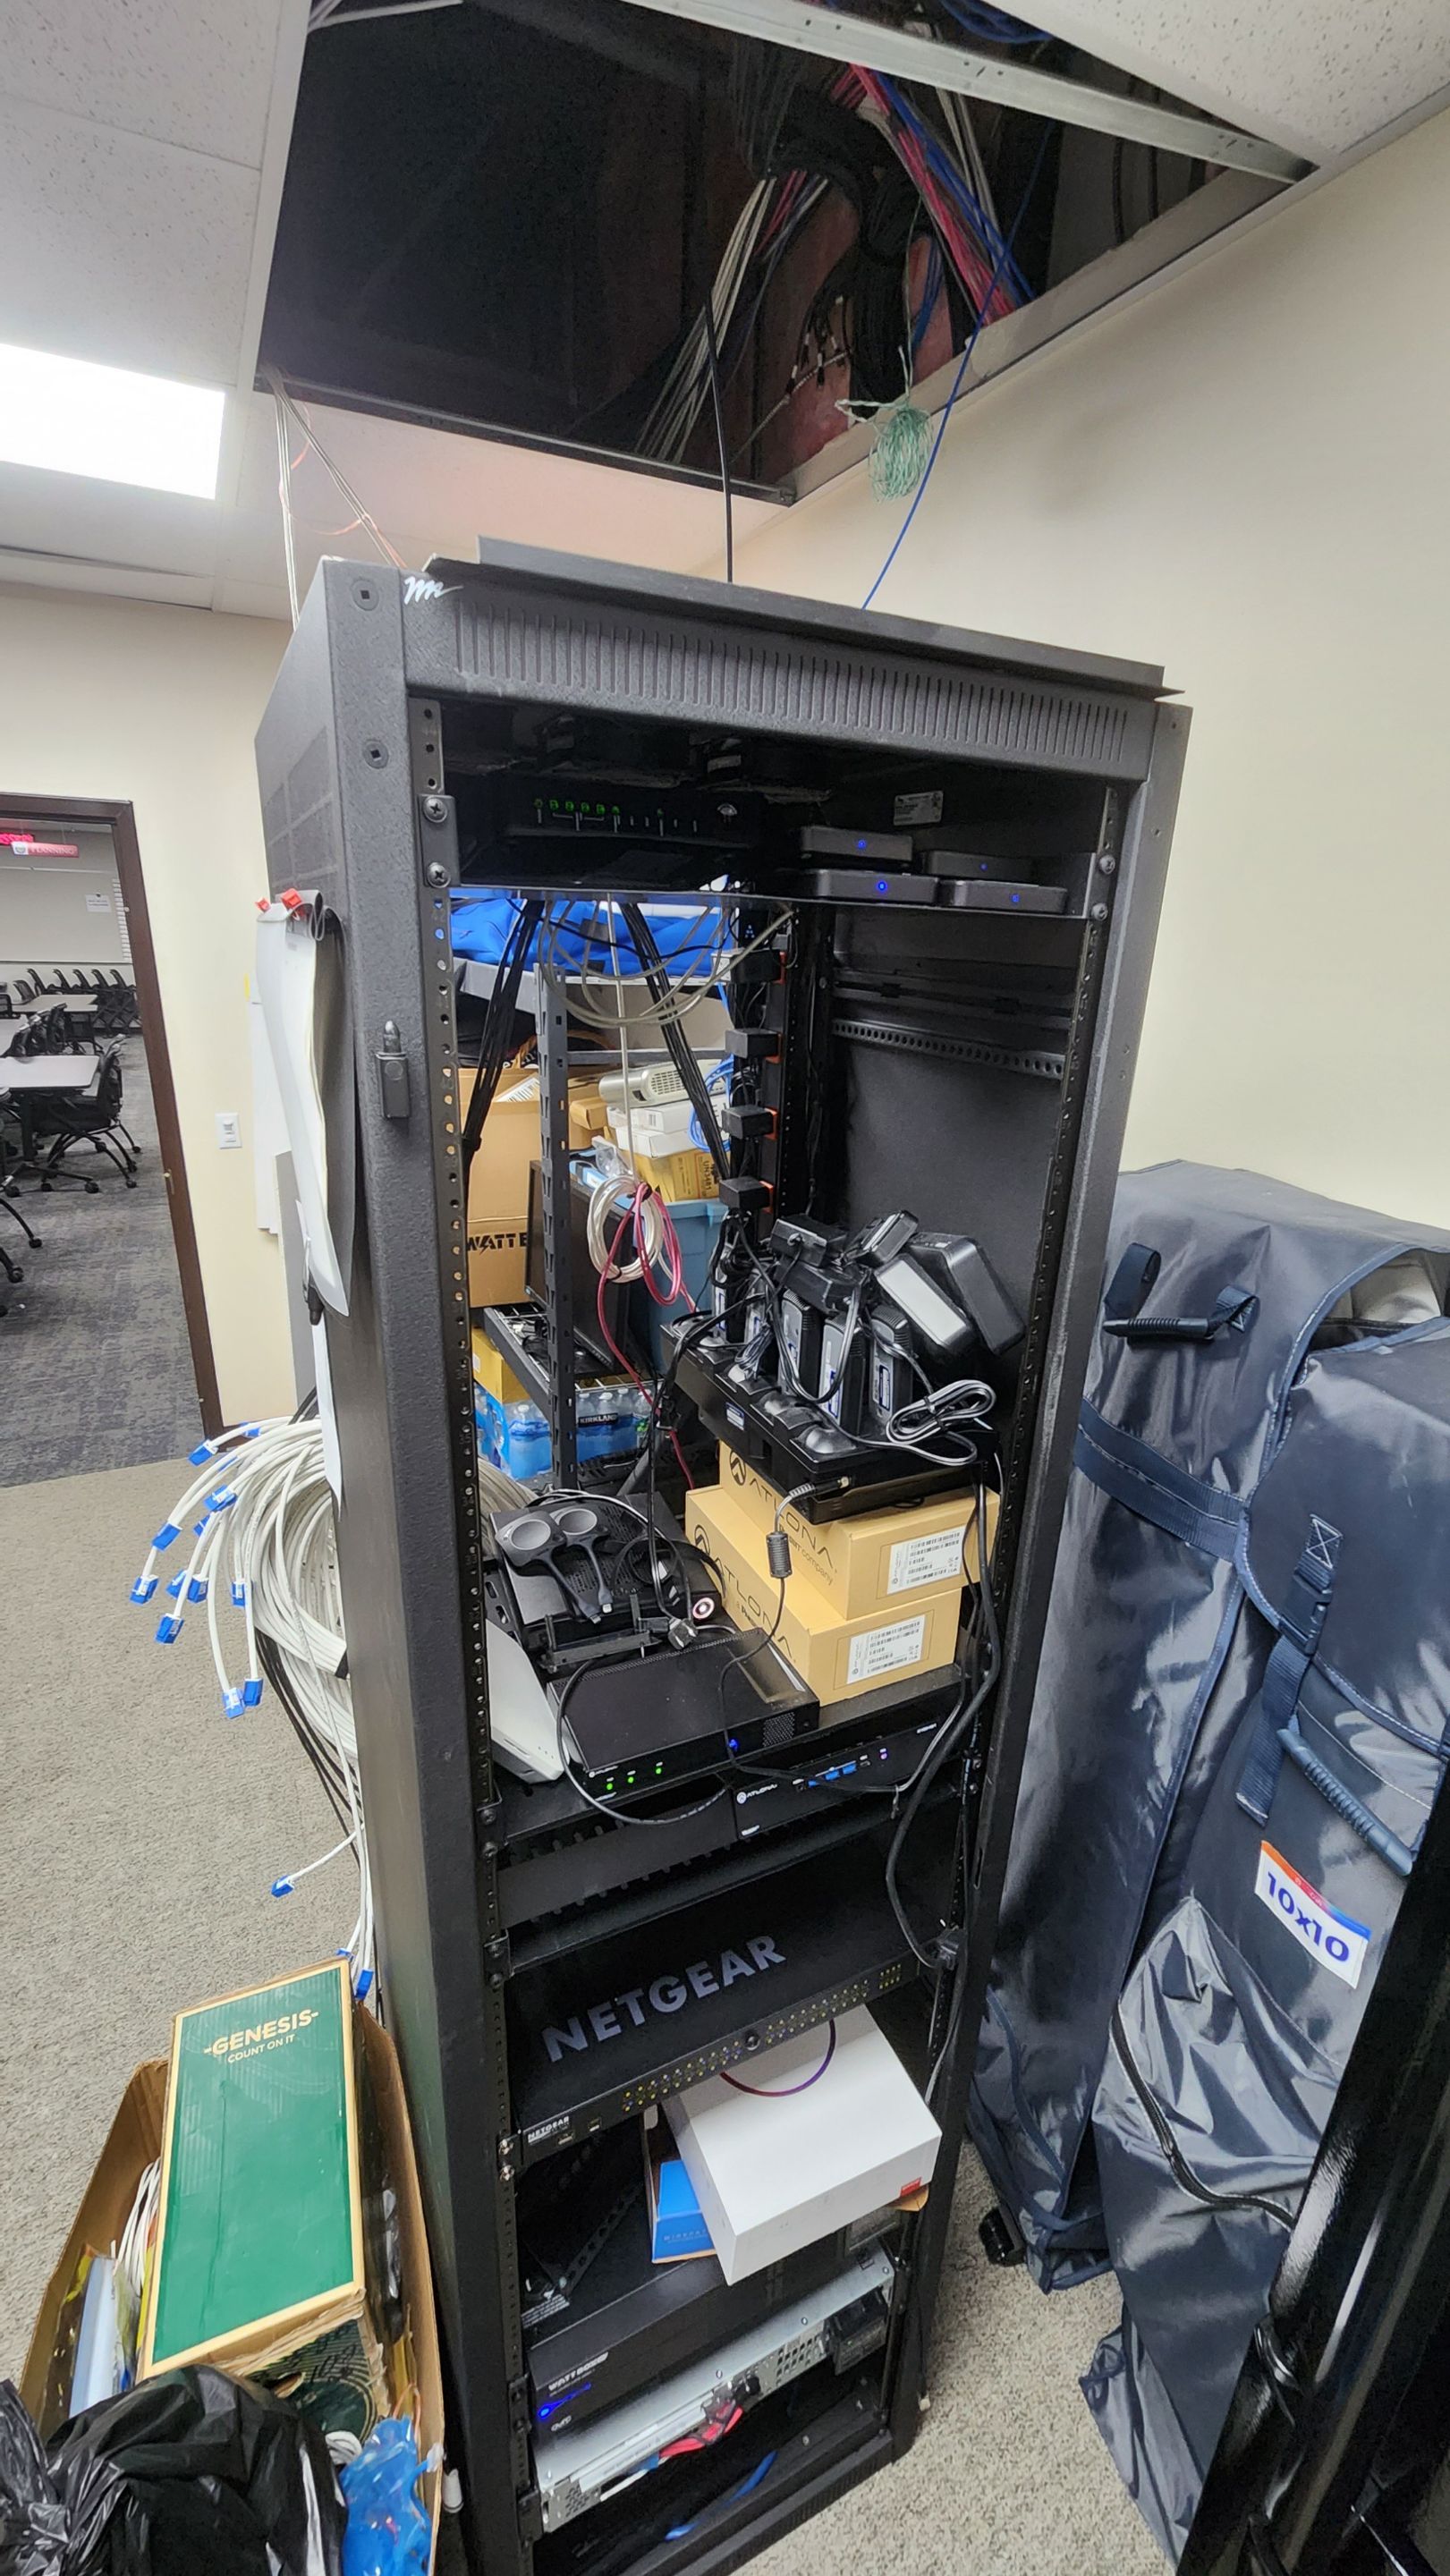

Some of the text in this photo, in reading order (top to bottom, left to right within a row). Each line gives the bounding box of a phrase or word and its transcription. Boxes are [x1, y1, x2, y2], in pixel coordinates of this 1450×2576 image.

[1267, 1870, 1350, 1962] 10x10
[541, 1935, 787, 2063] NETGEAR
[227, 2034, 296, 2063] COUNT ON IT
